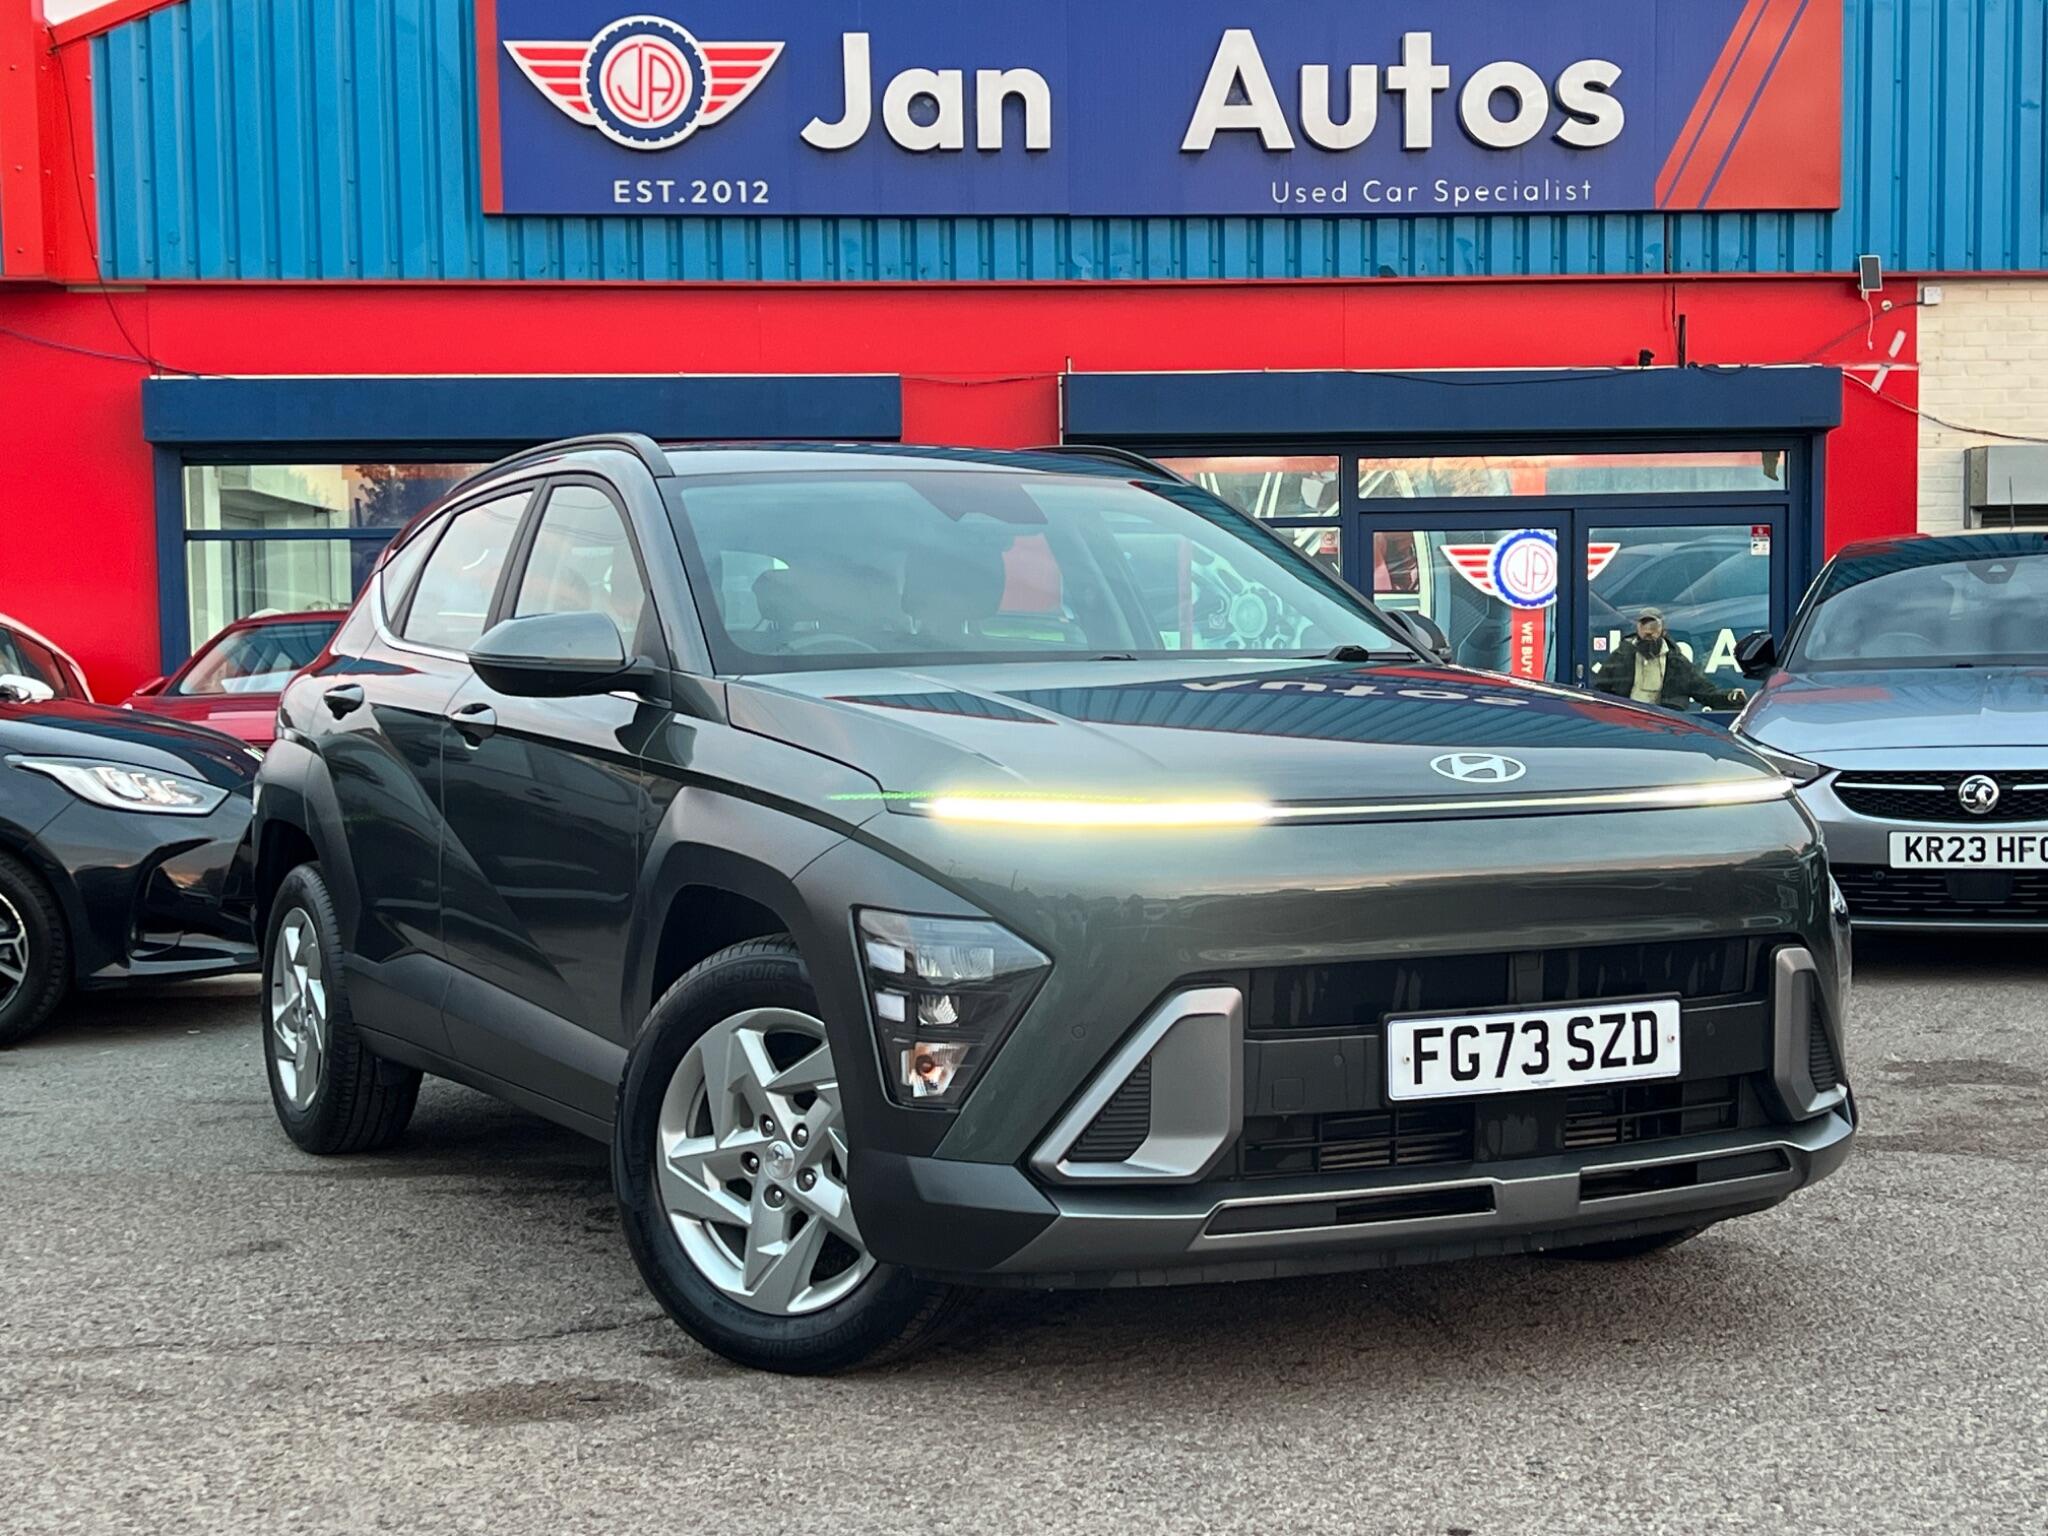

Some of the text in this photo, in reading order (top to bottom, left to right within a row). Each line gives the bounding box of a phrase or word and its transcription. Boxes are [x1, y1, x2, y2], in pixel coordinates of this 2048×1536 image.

[799, 28, 1625, 151] Jan Autos
[613, 180, 769, 204] EST.2012
[1271, 179, 1592, 206] Used Car Specialist
[1520, 621, 1534, 674] WE BUY
[1904, 836, 1987, 863] KR23
[1412, 1010, 1659, 1085] FG73 SZD
